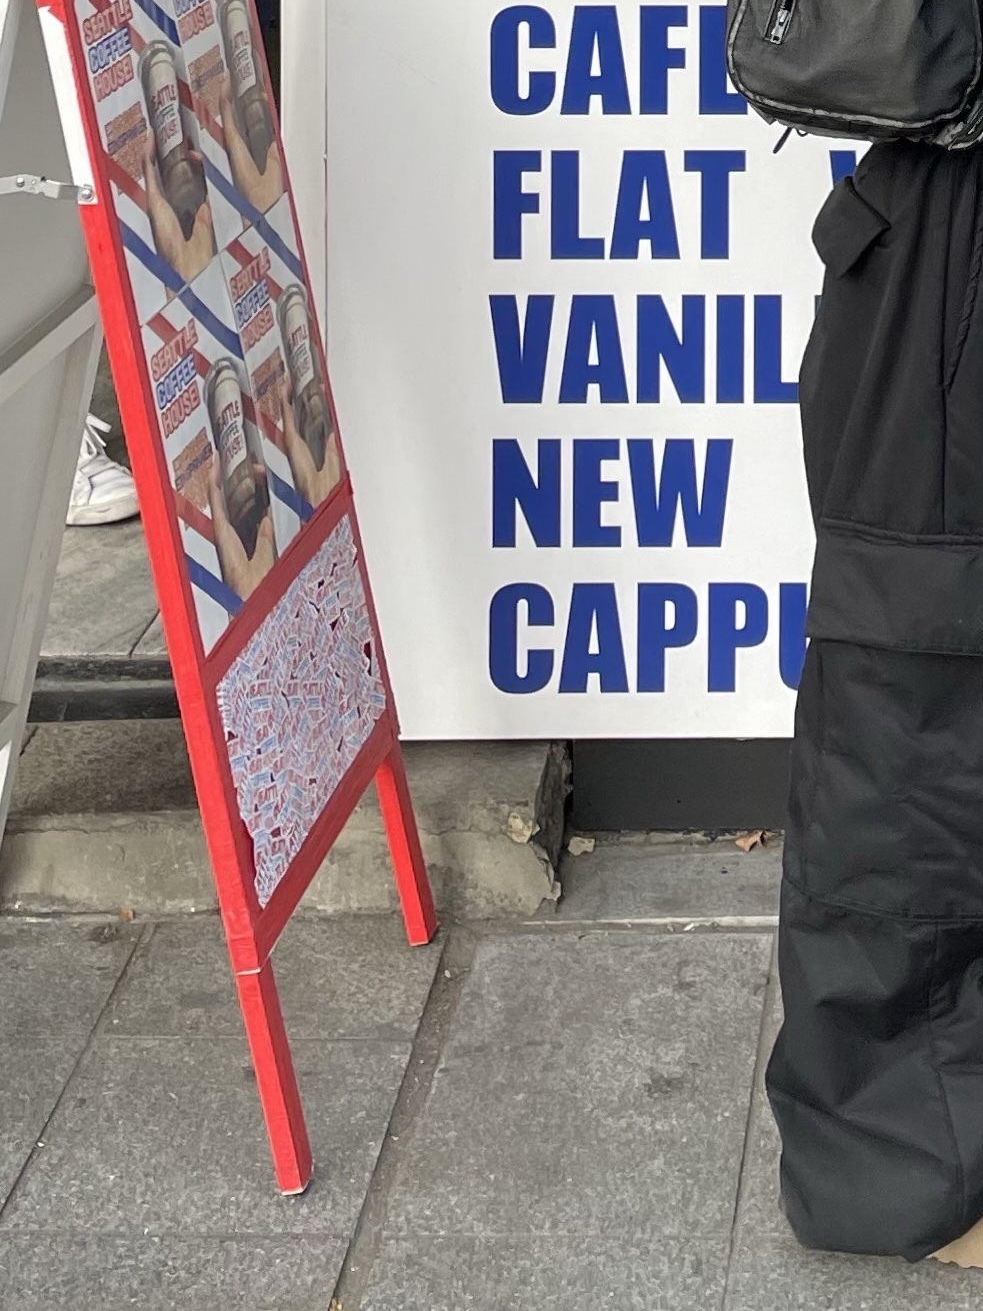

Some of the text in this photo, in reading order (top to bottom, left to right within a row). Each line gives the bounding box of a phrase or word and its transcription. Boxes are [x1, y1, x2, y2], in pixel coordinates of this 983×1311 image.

[88, 26, 133, 75] COFFEE
[93, 53, 135, 103] HOUSE
[493, 150, 747, 260] FLAT
[150, 316, 199, 383] SEATTLE
[155, 352, 197, 411] COFFEE
[488, 294, 802, 405] VANIL
[160, 379, 201, 440] HOUSE
[492, 439, 735, 549] NEW
[488, 582, 810, 694] CAPPU
